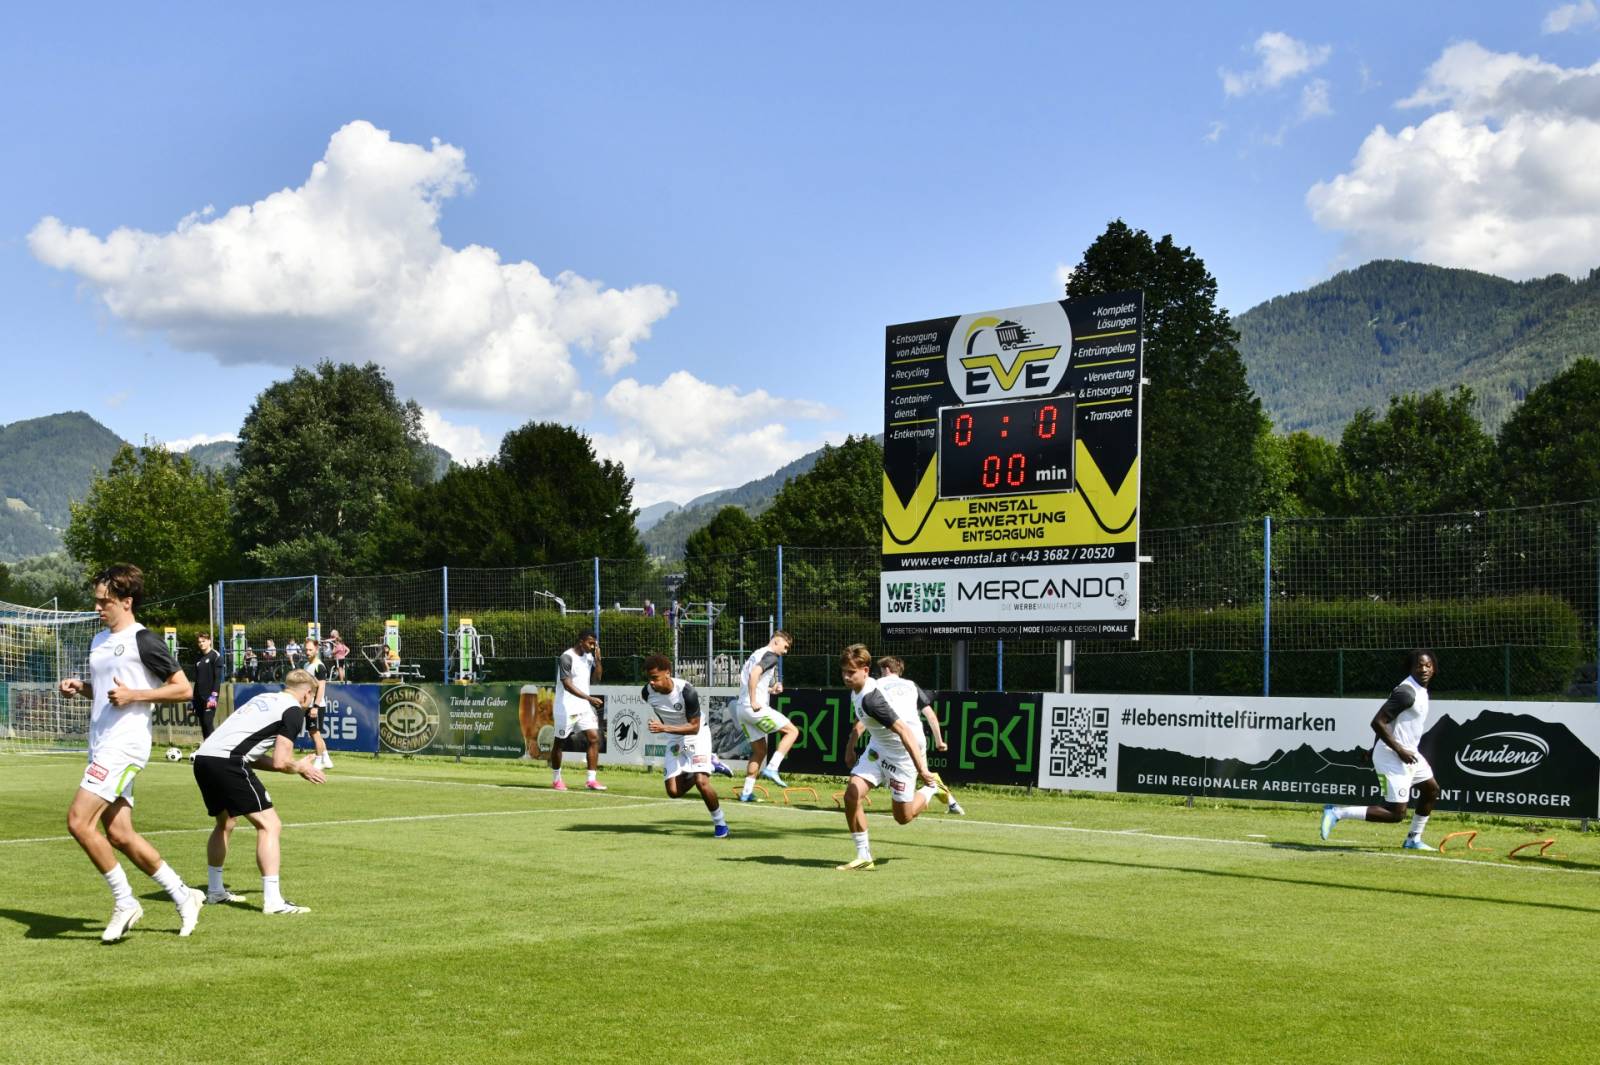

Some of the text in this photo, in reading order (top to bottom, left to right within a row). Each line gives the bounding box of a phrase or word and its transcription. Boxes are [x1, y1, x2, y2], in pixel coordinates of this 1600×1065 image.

[1097, 303, 1137, 317] Komplett-
[1097, 316, 1137, 330] Lösungen
[895, 331, 938, 345] Entsorgung
[896, 344, 941, 358] von Abfällen
[1078, 342, 1136, 358] Entrümpelung
[895, 367, 930, 380] Recycling
[960, 345, 1061, 395] EVE
[1088, 369, 1135, 382] Verwertung
[1086, 384, 1133, 398] Entsorgung
[895, 393, 933, 405] Container-
[894, 408, 917, 419] dienst
[1090, 407, 1133, 421] Transporte
[955, 414, 973, 446] 0
[1039, 405, 1057, 438] 0
[982, 453, 1067, 488] 00 min
[968, 499, 1039, 514] ENNSTAL
[944, 511, 1066, 529] VERWERTUNG
[962, 527, 1045, 543] ENTSORGUNG
[901, 551, 1007, 568] www.eve-ennstal.at
[1019, 551, 1040, 562] +43
[1042, 549, 1069, 561] 3682
[1080, 547, 1115, 560] 20520
[886, 582, 913, 600] WE
[922, 581, 946, 598] WE
[958, 576, 1125, 601] MERCANDO
[888, 601, 913, 613] LOVE
[922, 598, 946, 613] DO!
[933, 626, 973, 634] WERBEMITTEL
[1022, 625, 1040, 633] MODE
[1075, 625, 1098, 633] DESIGN
[1102, 624, 1129, 633] POKALE
[385, 690, 427, 705] GASTHOF
[472, 697, 486, 706] und
[449, 709, 494, 719] wünschen ein
[1121, 707, 1336, 732] #lebensmittelfürmarken
[449, 721, 473, 731] schönes
[1461, 744, 1544, 765] Landena
[1137, 773, 1168, 786] DEIN
[1172, 775, 1258, 791] REGIONALER
[1262, 780, 1356, 796] ARBEITGEBER
[1475, 790, 1571, 807] VERSORGER
